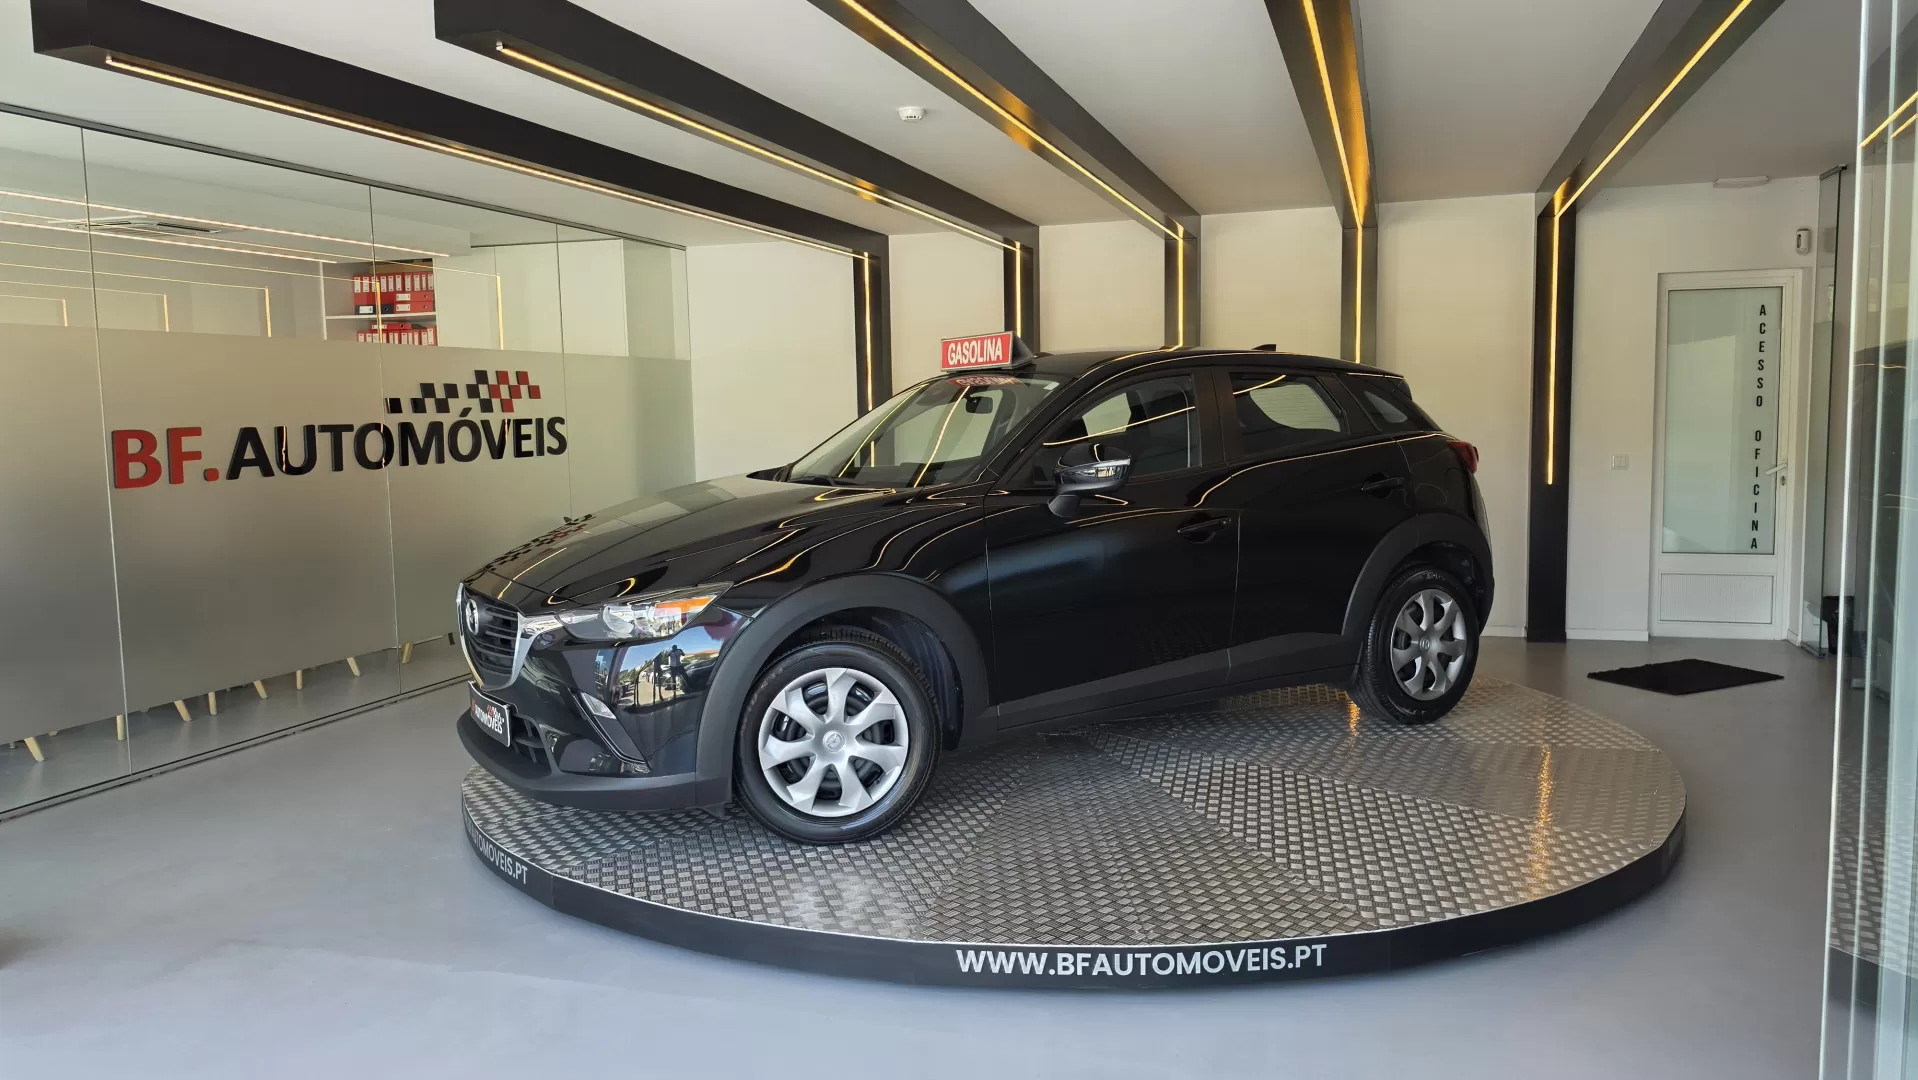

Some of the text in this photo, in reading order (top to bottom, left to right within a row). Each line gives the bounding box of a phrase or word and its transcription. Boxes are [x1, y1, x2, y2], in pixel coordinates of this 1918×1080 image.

[948, 337, 1003, 365] GASOLINA
[111, 407, 568, 489] BF.AUTOMÓVEIS
[1750, 304, 1767, 549] ACESSO OFICINA
[956, 943, 1327, 976] WWW.BFAUTOMOVEIS.PT
